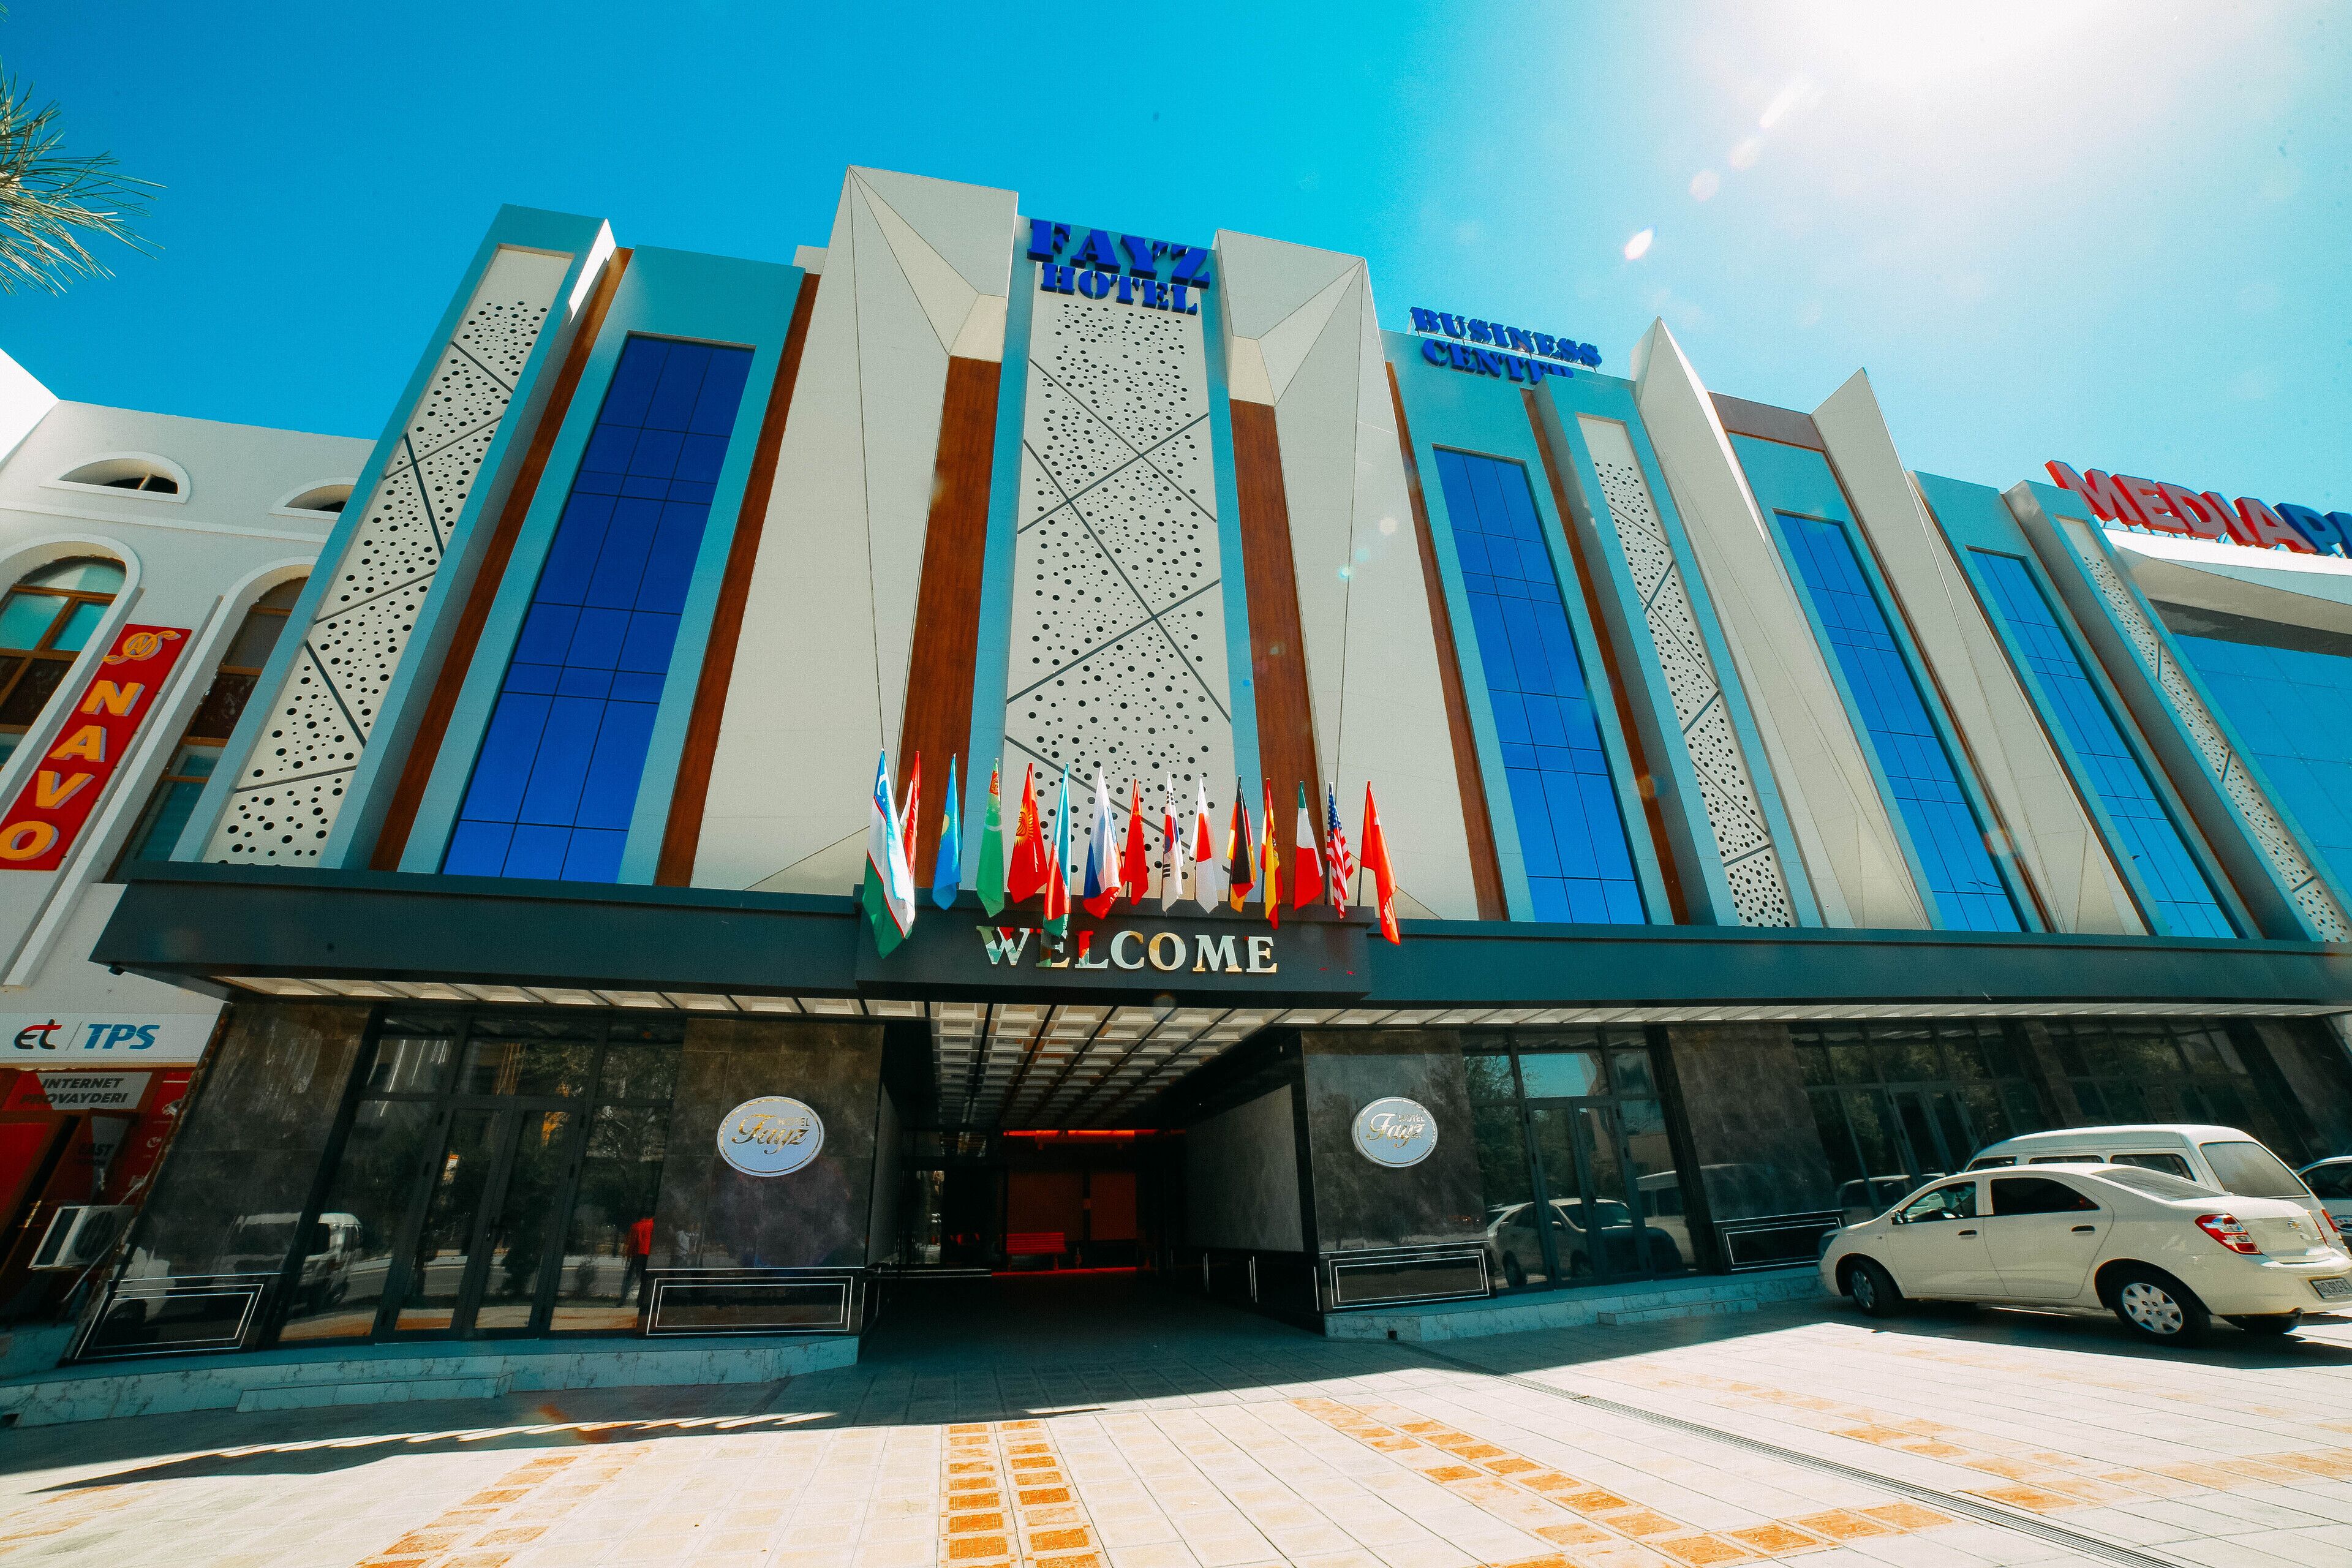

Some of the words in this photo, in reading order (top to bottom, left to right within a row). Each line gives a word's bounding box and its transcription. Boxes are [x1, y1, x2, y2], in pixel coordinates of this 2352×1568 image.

[1027, 218, 1210, 290] FAYZ
[1040, 262, 1197, 316] HOTEL
[1410, 306, 1602, 368] BUSINESS
[0, 680, 145, 861] NAVO
[976, 925, 1278, 973] WELCOME
[84, 1023, 160, 1050] TPS
[42, 1078, 124, 1088] INTERNET
[731, 1114, 809, 1155] Fayz
[1366, 1112, 1425, 1148] Fayz
